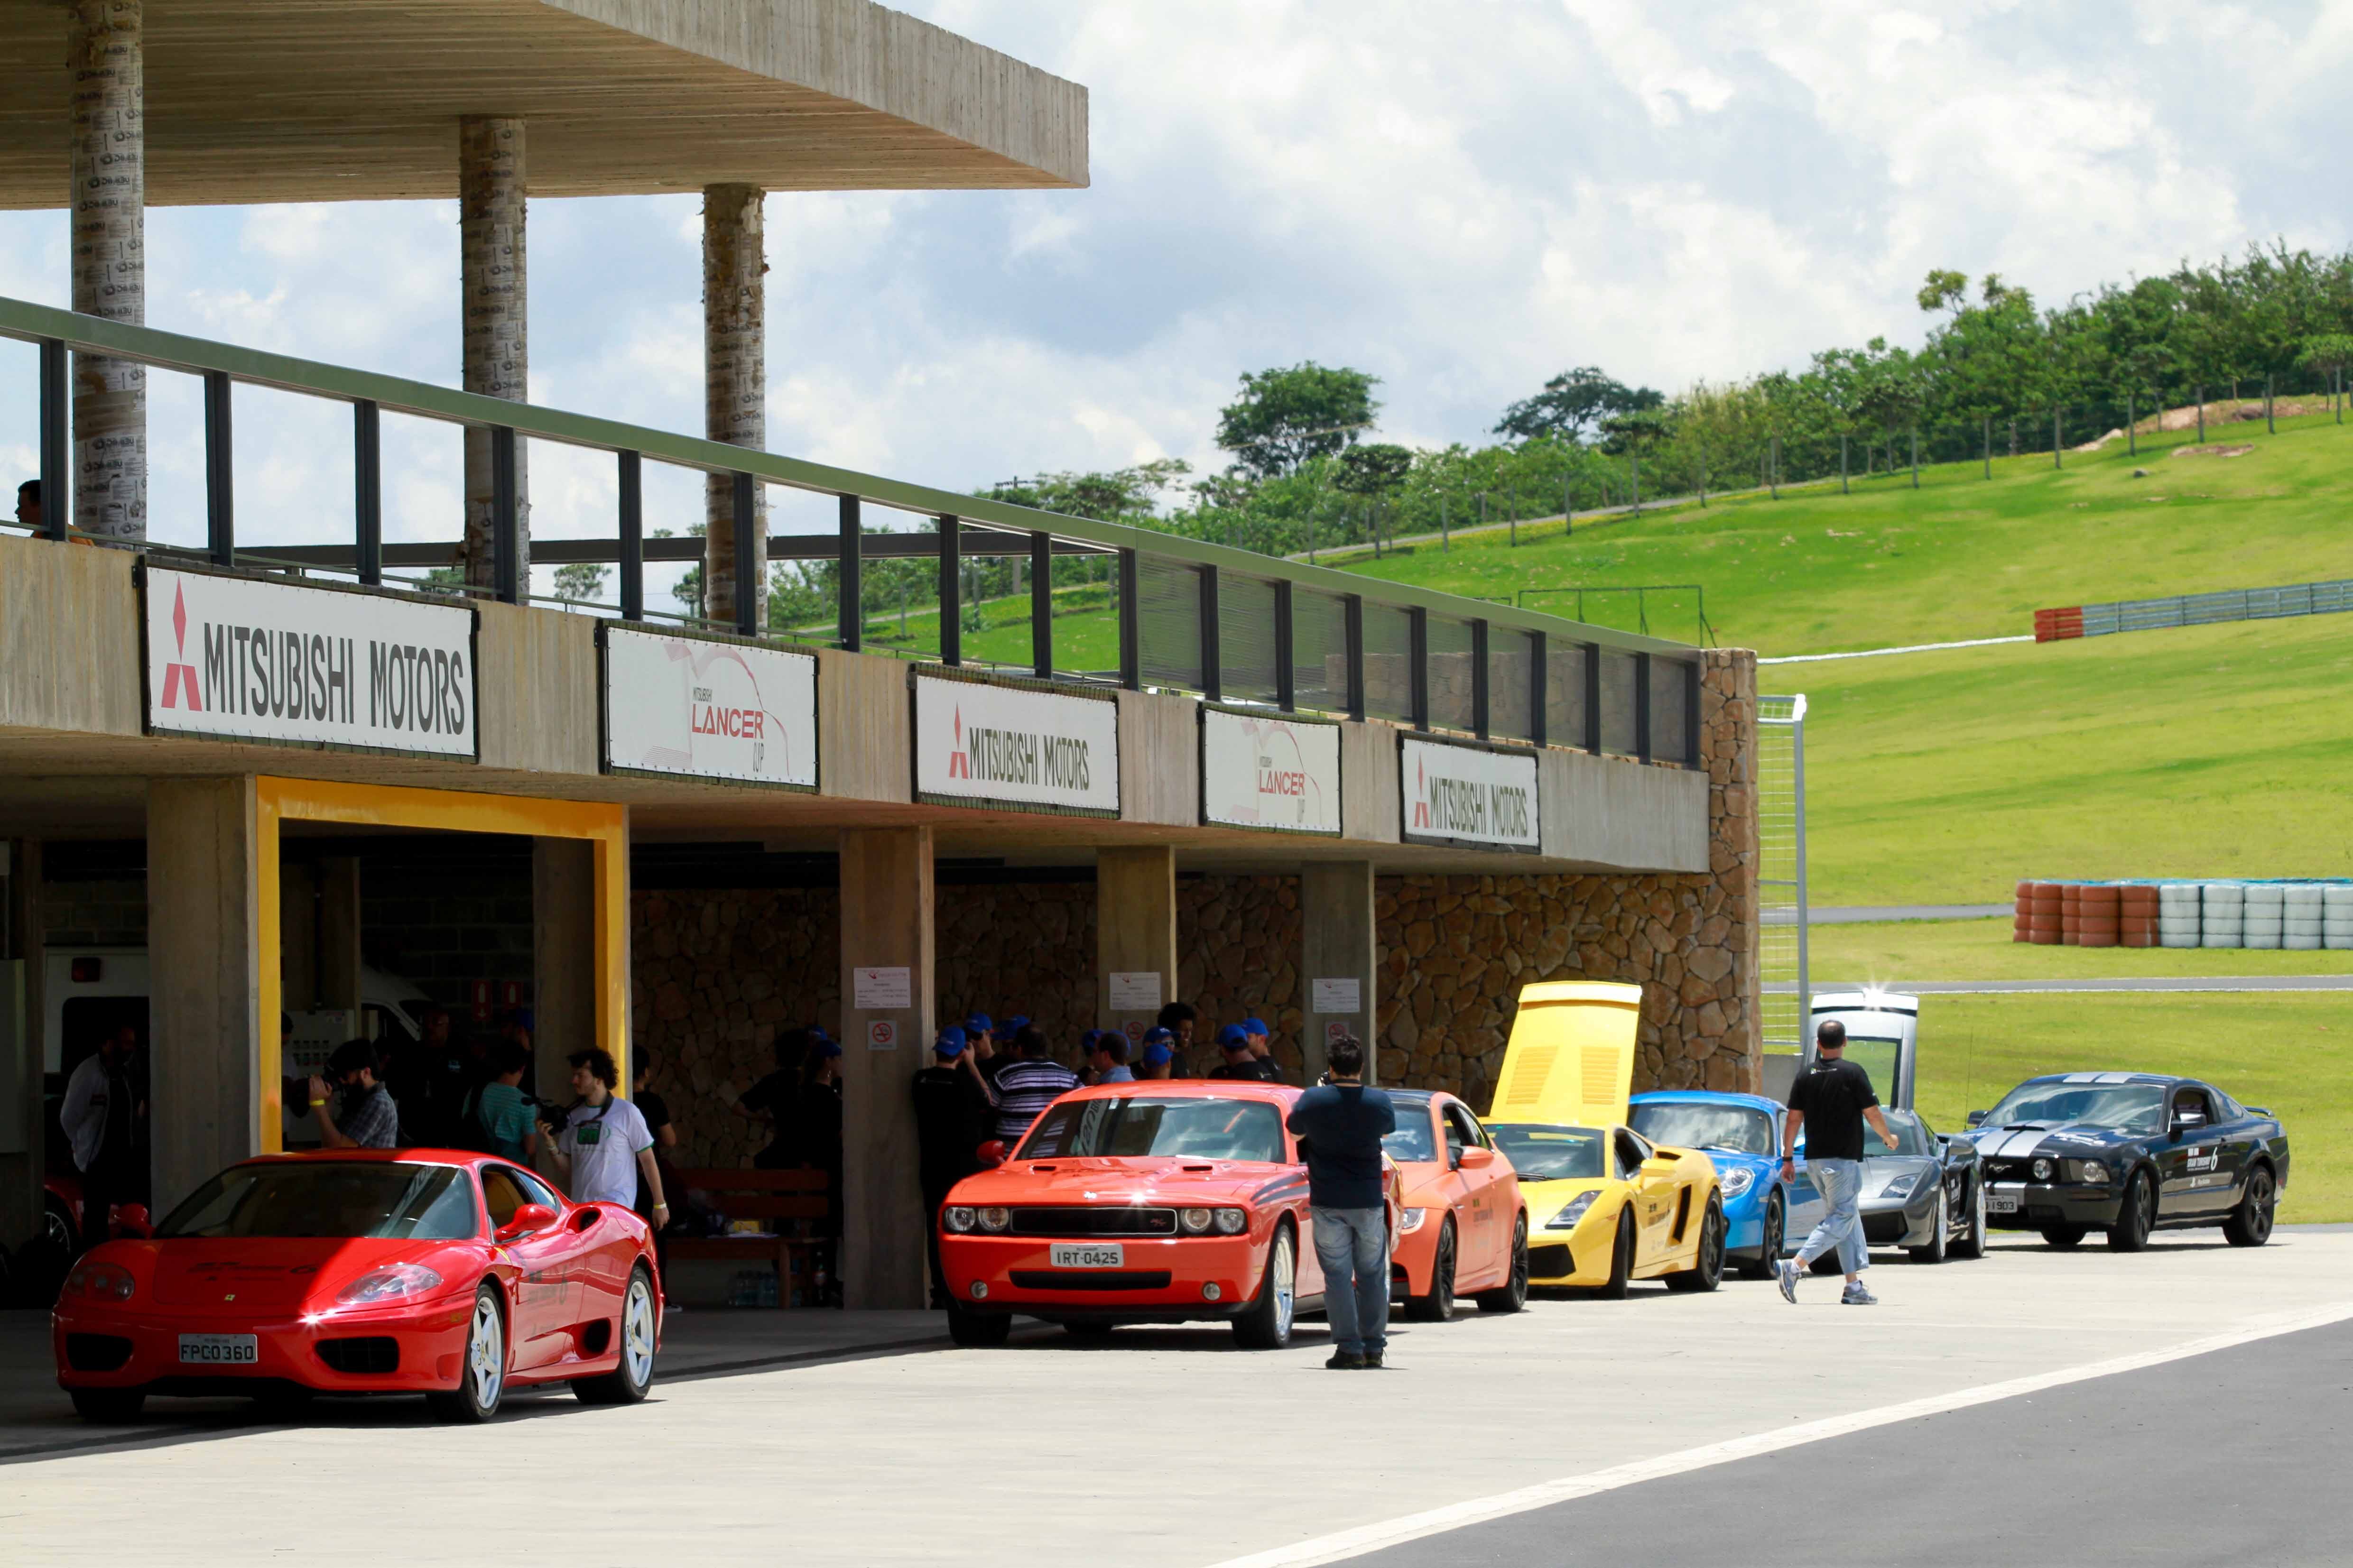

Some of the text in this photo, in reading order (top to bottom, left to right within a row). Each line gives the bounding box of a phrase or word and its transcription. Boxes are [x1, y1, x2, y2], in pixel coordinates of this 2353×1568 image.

[204, 622, 465, 735] MITSUBISHI MOTORS
[692, 704, 764, 739] LANCER
[970, 727, 1090, 791] MITSUBISHI MOTORS
[1259, 770, 1305, 795] LANCER
[1430, 776, 1528, 838] MITSUBISHI MOTORS
